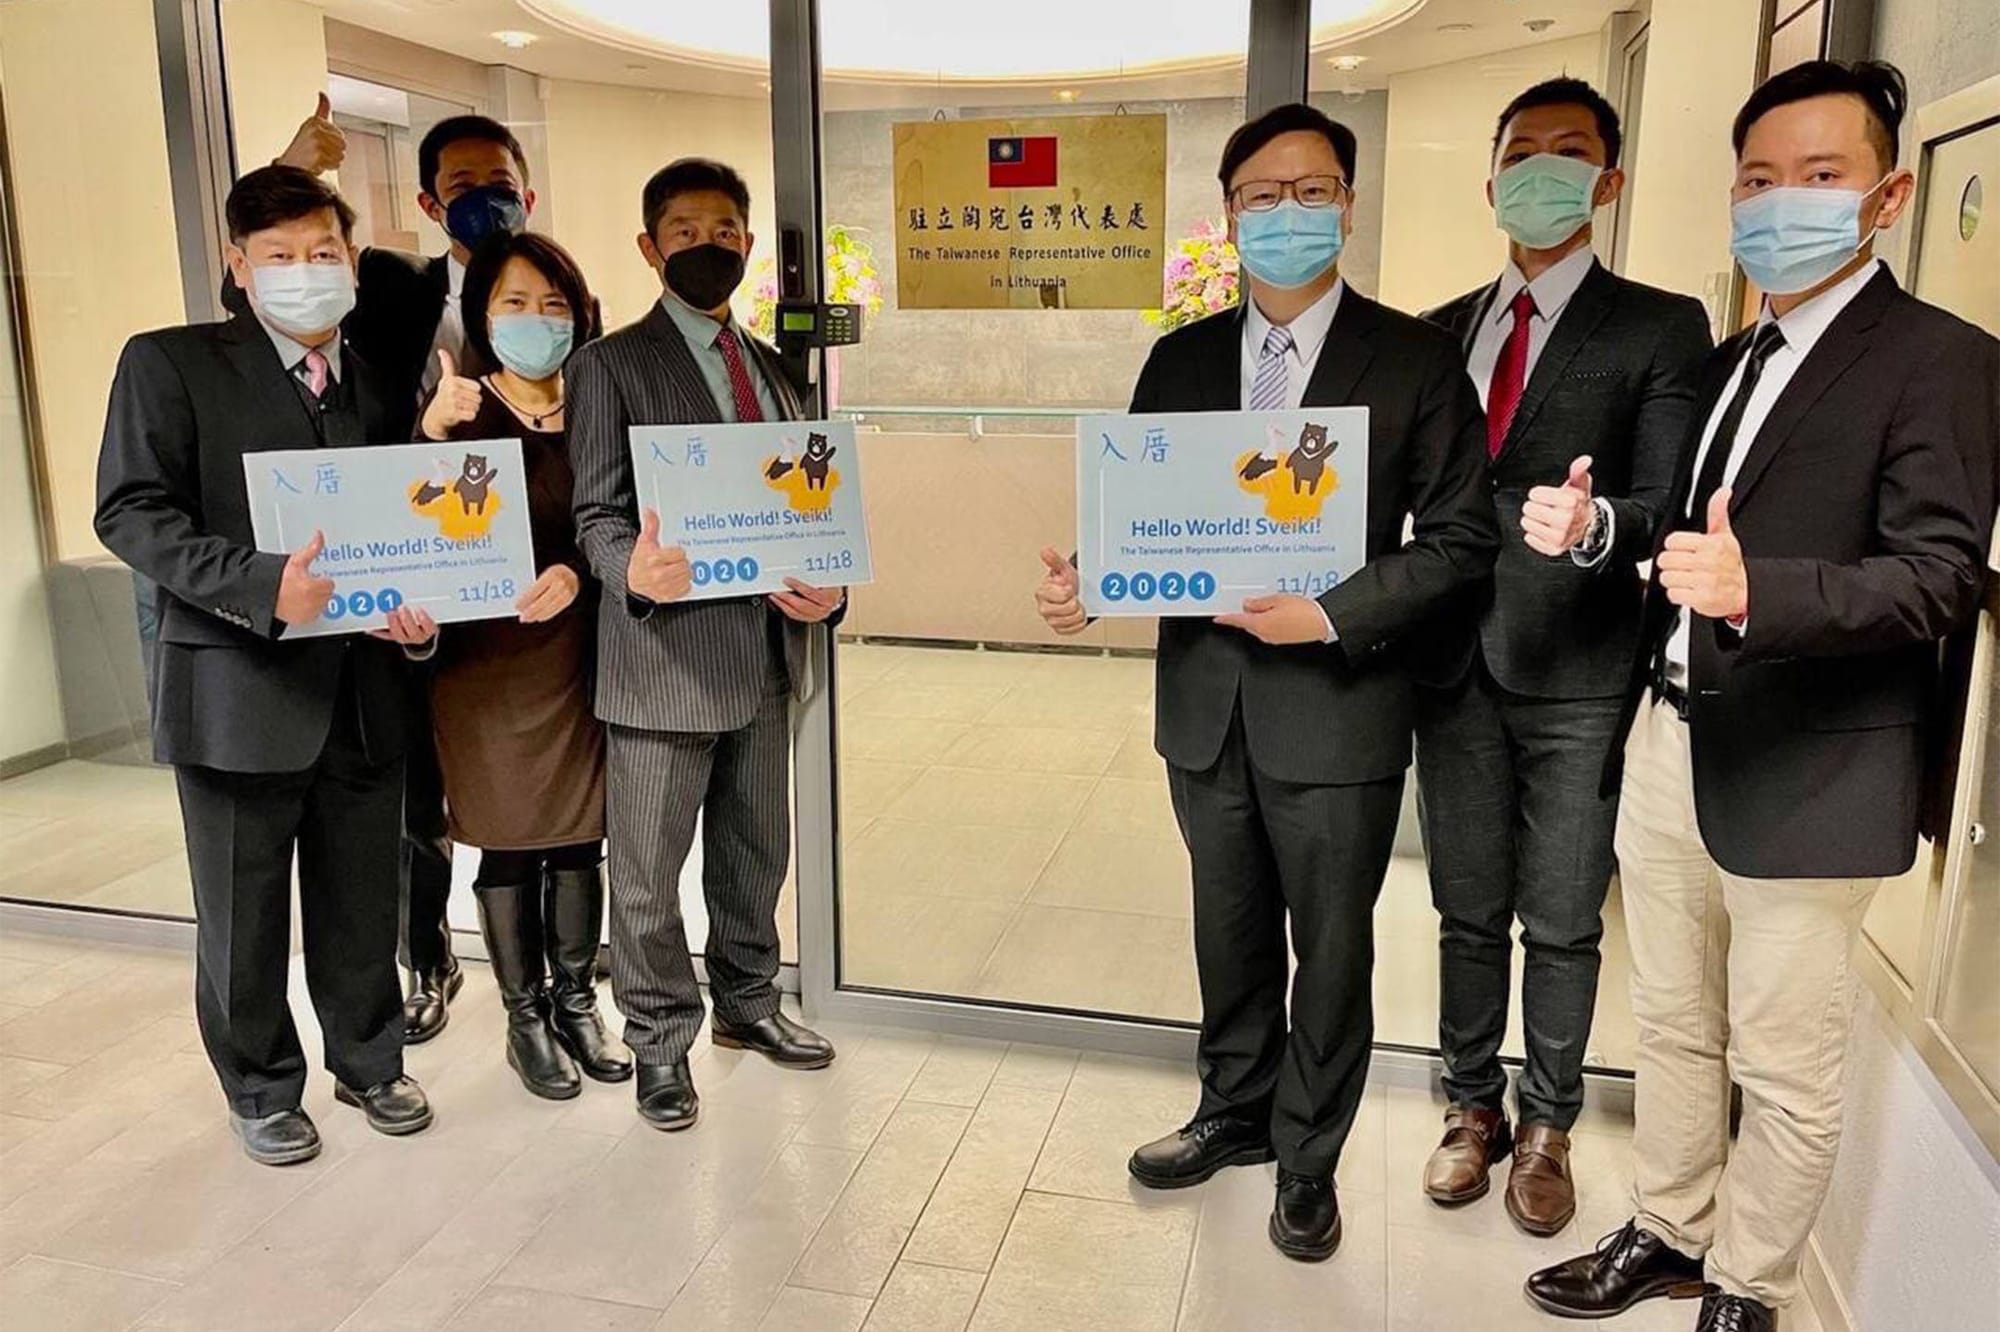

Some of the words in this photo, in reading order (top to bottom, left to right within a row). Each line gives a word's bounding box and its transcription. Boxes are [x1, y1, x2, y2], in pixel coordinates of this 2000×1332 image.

[908, 202, 1149, 232] 駐立陶宛台灣代表處
[908, 247, 931, 261] The
[936, 247, 1001, 261] Taiwanese
[1009, 246, 1106, 265] Representative
[1111, 245, 1152, 260] Office
[1008, 274, 1067, 289] Lithuania
[684, 515, 726, 531] Hello
[727, 511, 780, 529] World!
[782, 508, 833, 525] Sveiki!
[1131, 519, 1181, 537] Hello
[1185, 518, 1249, 536] World!
[1256, 517, 1321, 535] Sveiki!
[367, 539, 428, 558] World!
[433, 534, 492, 553] Sveiki!
[785, 532, 805, 541] Office
[1120, 546, 1135, 556] The
[1138, 546, 1183, 556] Taiwanese
[1185, 545, 1252, 557] Representative
[1254, 543, 1280, 554] Office
[1282, 543, 1291, 553] in
[1293, 543, 1336, 553] Lithuania
[435, 559, 458, 570] Office
[805, 549, 853, 573] 11/18
[458, 578, 515, 603] 11/18
[1107, 577, 1207, 597] 2021
[1277, 570, 1339, 596] 11/18
